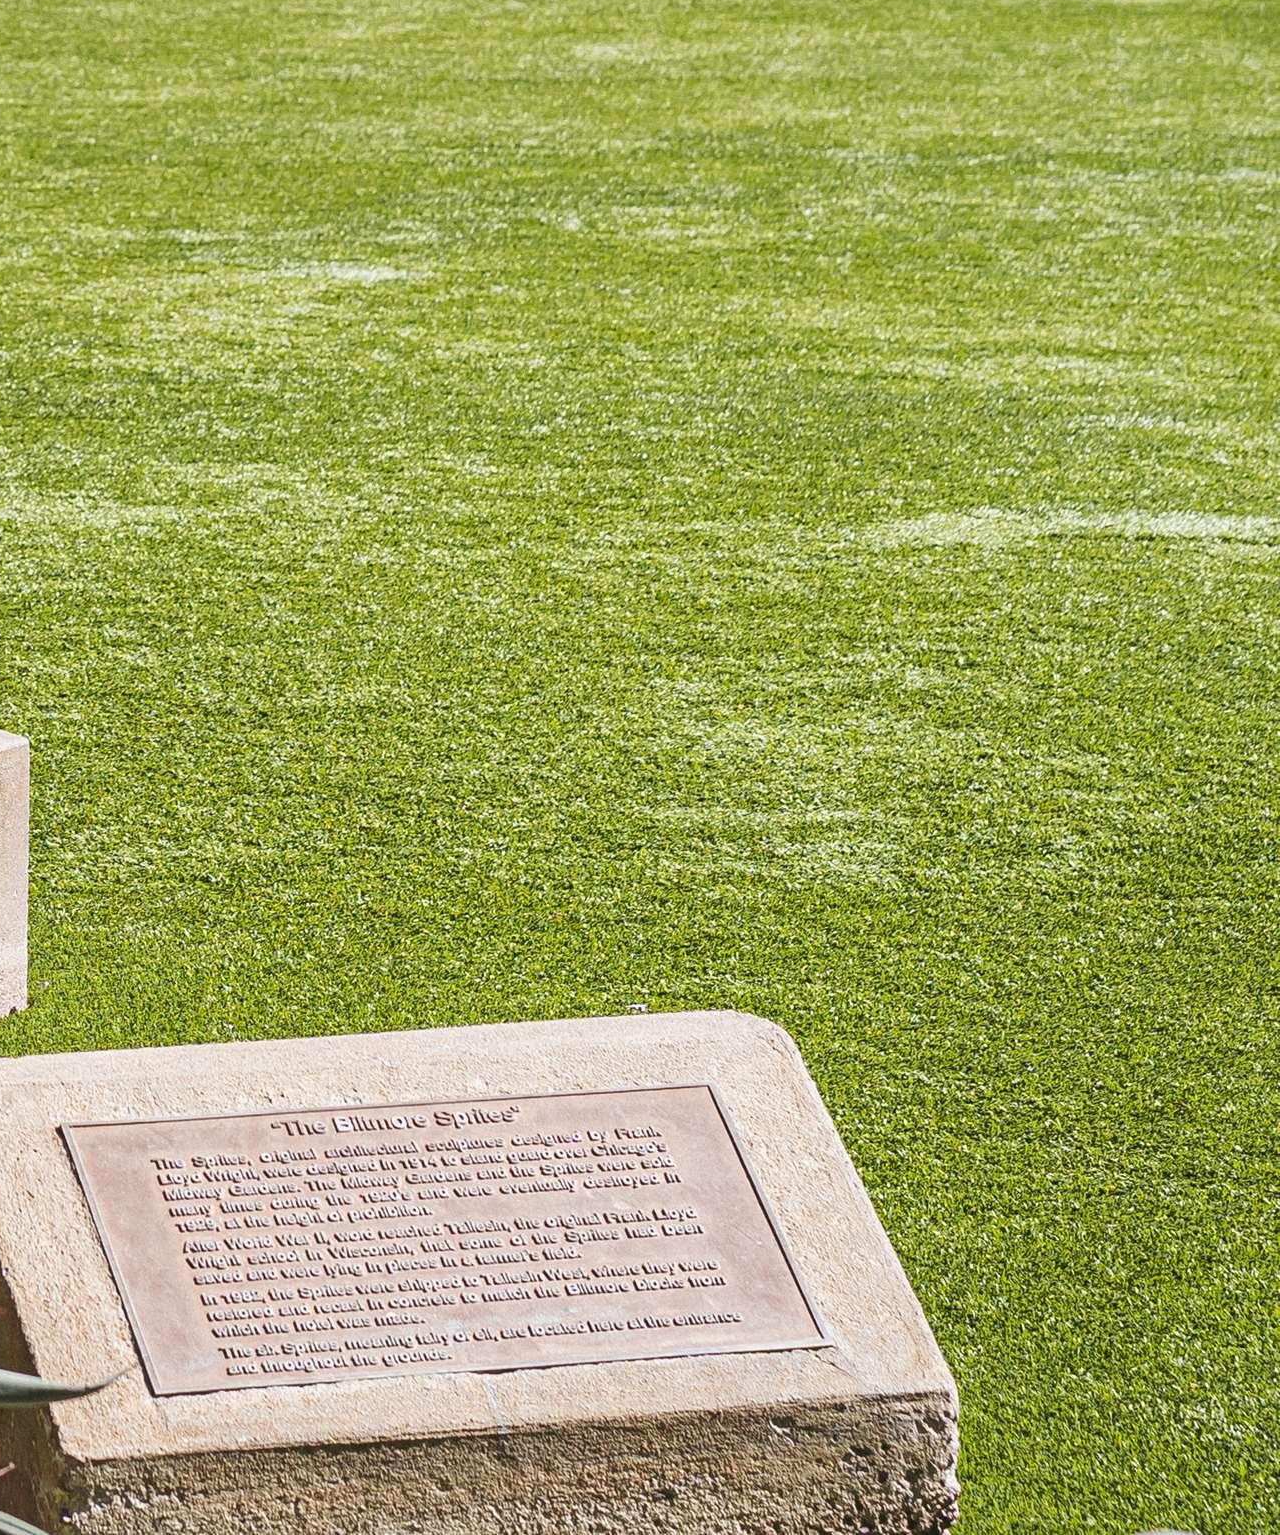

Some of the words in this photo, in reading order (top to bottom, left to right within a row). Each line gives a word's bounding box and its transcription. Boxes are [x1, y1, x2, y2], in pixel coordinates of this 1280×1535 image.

[333, 1114, 427, 1134] Biltmore
[151, 1157, 183, 1170] The
[259, 1149, 316, 1164] original
[325, 1142, 418, 1158] architectural
[425, 1136, 503, 1153] sculptures
[511, 1131, 581, 1147] designed
[588, 1130, 609, 1143] by
[615, 1126, 662, 1140] Frank
[157, 1173, 201, 1187] Lloyd
[264, 1167, 303, 1178] were
[306, 1159, 377, 1176] designed
[381, 1158, 396, 1170] in
[441, 1155, 457, 1167] to
[461, 1151, 503, 1165] stand
[506, 1149, 551, 1164] guard
[555, 1147, 587, 1159] over
[591, 1141, 667, 1157] Chicago's
[163, 1187, 222, 1202] Midway
[304, 1180, 336, 1192] The
[341, 1175, 399, 1190] Midway
[406, 1171, 471, 1185] Gardens
[477, 1169, 506, 1181] and
[510, 1166, 535, 1178] the
[541, 1162, 594, 1176] Sprites
[598, 1159, 637, 1172] were
[642, 1155, 675, 1169] sold
[169, 1204, 212, 1218] many
[220, 1201, 263, 1213] times
[271, 1197, 321, 1211] during
[327, 1194, 352, 1206] the
[419, 1188, 449, 1199] and
[454, 1185, 492, 1197] were
[499, 1178, 577, 1195] eventually
[583, 1173, 660, 1190] destroyed
[664, 1172, 681, 1184] in
[183, 1238, 220, 1253] After
[224, 1234, 273, 1250] World
[275, 1233, 309, 1247] War
[334, 1228, 373, 1242] word
[378, 1225, 442, 1239] reached
[514, 1217, 540, 1229] the
[544, 1213, 601, 1229] original
[603, 1209, 651, 1223] Frank
[653, 1207, 697, 1220] Lloyd
[225, 1218, 241, 1229] at
[245, 1215, 270, 1228] the
[274, 1210, 324, 1226] height
[327, 1209, 343, 1222] of
[186, 1255, 241, 1269] Wright
[248, 1251, 299, 1264] school
[306, 1249, 322, 1261] in
[421, 1240, 453, 1253] that
[460, 1238, 503, 1250] some
[510, 1235, 527, 1246] of
[532, 1233, 557, 1244] the
[565, 1229, 620, 1243] Sprites
[625, 1226, 658, 1239] had
[662, 1223, 704, 1236] been
[194, 1271, 241, 1285] saved
[247, 1268, 278, 1281] and
[281, 1266, 320, 1278] were
[325, 1262, 361, 1277] lying
[366, 1261, 382, 1273] in
[386, 1257, 437, 1273] pieces
[441, 1254, 457, 1267] in
[461, 1254, 473, 1265] a
[476, 1251, 540, 1265] farmer's
[201, 1293, 217, 1305] In
[268, 1288, 293, 1301] the
[298, 1284, 353, 1300] Sprites
[356, 1281, 392, 1294] were
[398, 1276, 462, 1293] shipped
[462, 1274, 478, 1287] to
[481, 1269, 542, 1285] Taliesin
[591, 1263, 640, 1278] where
[642, 1261, 676, 1275] they
[679, 1258, 718, 1271] were
[207, 1307, 274, 1322] restored
[279, 1304, 309, 1316] and
[314, 1300, 364, 1314] recast
[368, 1298, 384, 1311] in
[388, 1294, 455, 1310] concrete
[460, 1292, 476, 1303] to
[482, 1287, 531, 1302] match
[534, 1285, 560, 1298] the
[565, 1281, 630, 1296] Biltmore
[633, 1277, 684, 1291] blocks
[688, 1275, 726, 1287] from
[212, 1322, 260, 1338] which
[263, 1320, 289, 1334] the
[293, 1318, 333, 1331] hotel
[337, 1317, 370, 1328] was
[218, 1346, 251, 1359] The
[345, 1334, 416, 1350] meaning
[416, 1331, 449, 1346] fairy
[453, 1330, 470, 1342] or
[501, 1326, 527, 1338] are
[528, 1321, 587, 1337] located
[588, 1319, 623, 1332] here
[627, 1318, 645, 1329] at
[644, 1316, 671, 1328] the
[673, 1312, 742, 1325] entrance
[227, 1363, 258, 1376] and
[261, 1353, 348, 1373] throughout
[353, 1353, 377, 1365] the
